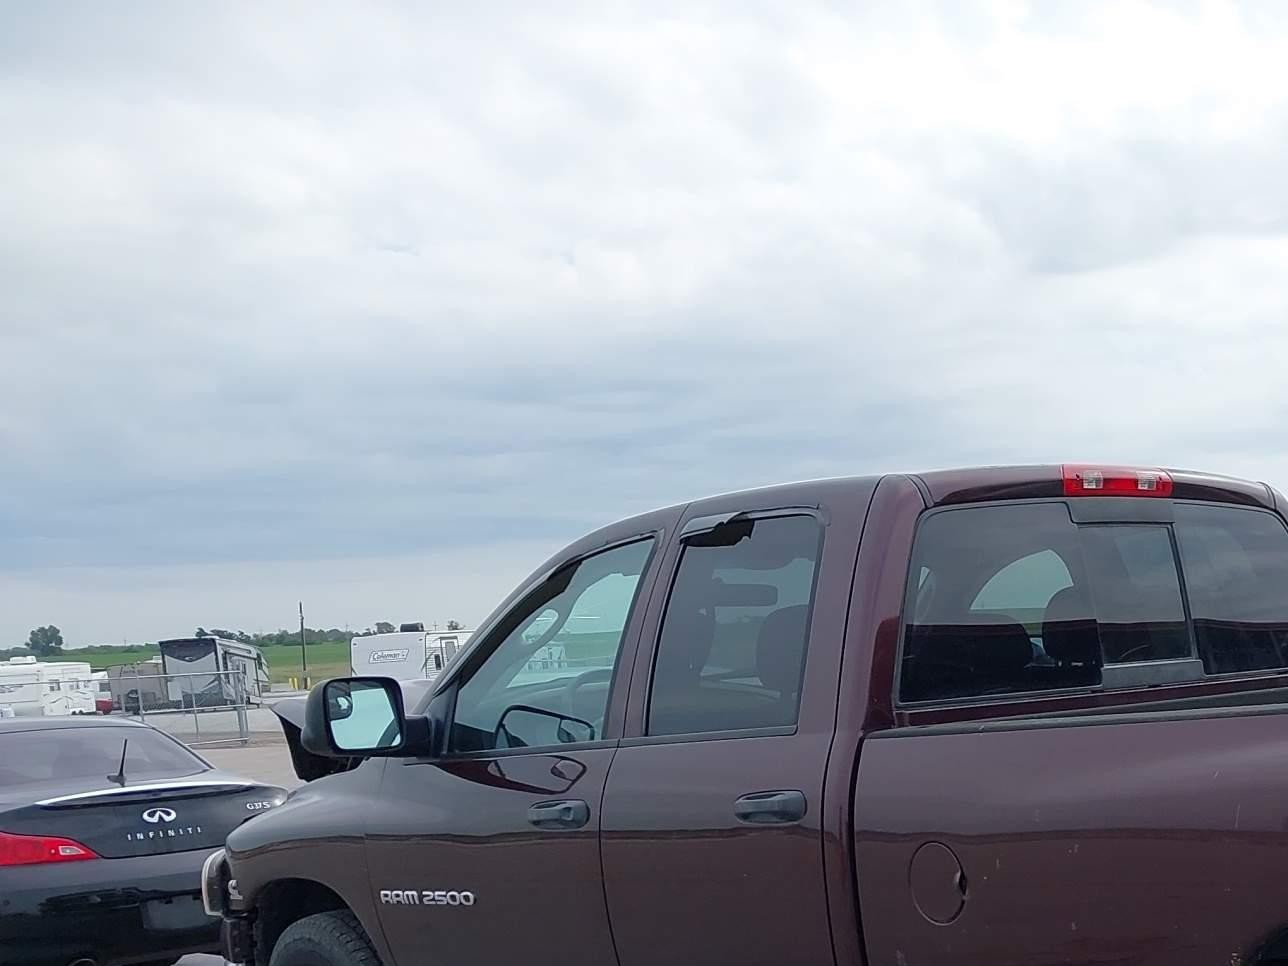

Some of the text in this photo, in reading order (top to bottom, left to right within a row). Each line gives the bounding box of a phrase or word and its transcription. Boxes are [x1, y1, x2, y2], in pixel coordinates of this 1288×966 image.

[127, 827, 202, 841] INFINITI
[380, 890, 475, 906] RAM 2500
